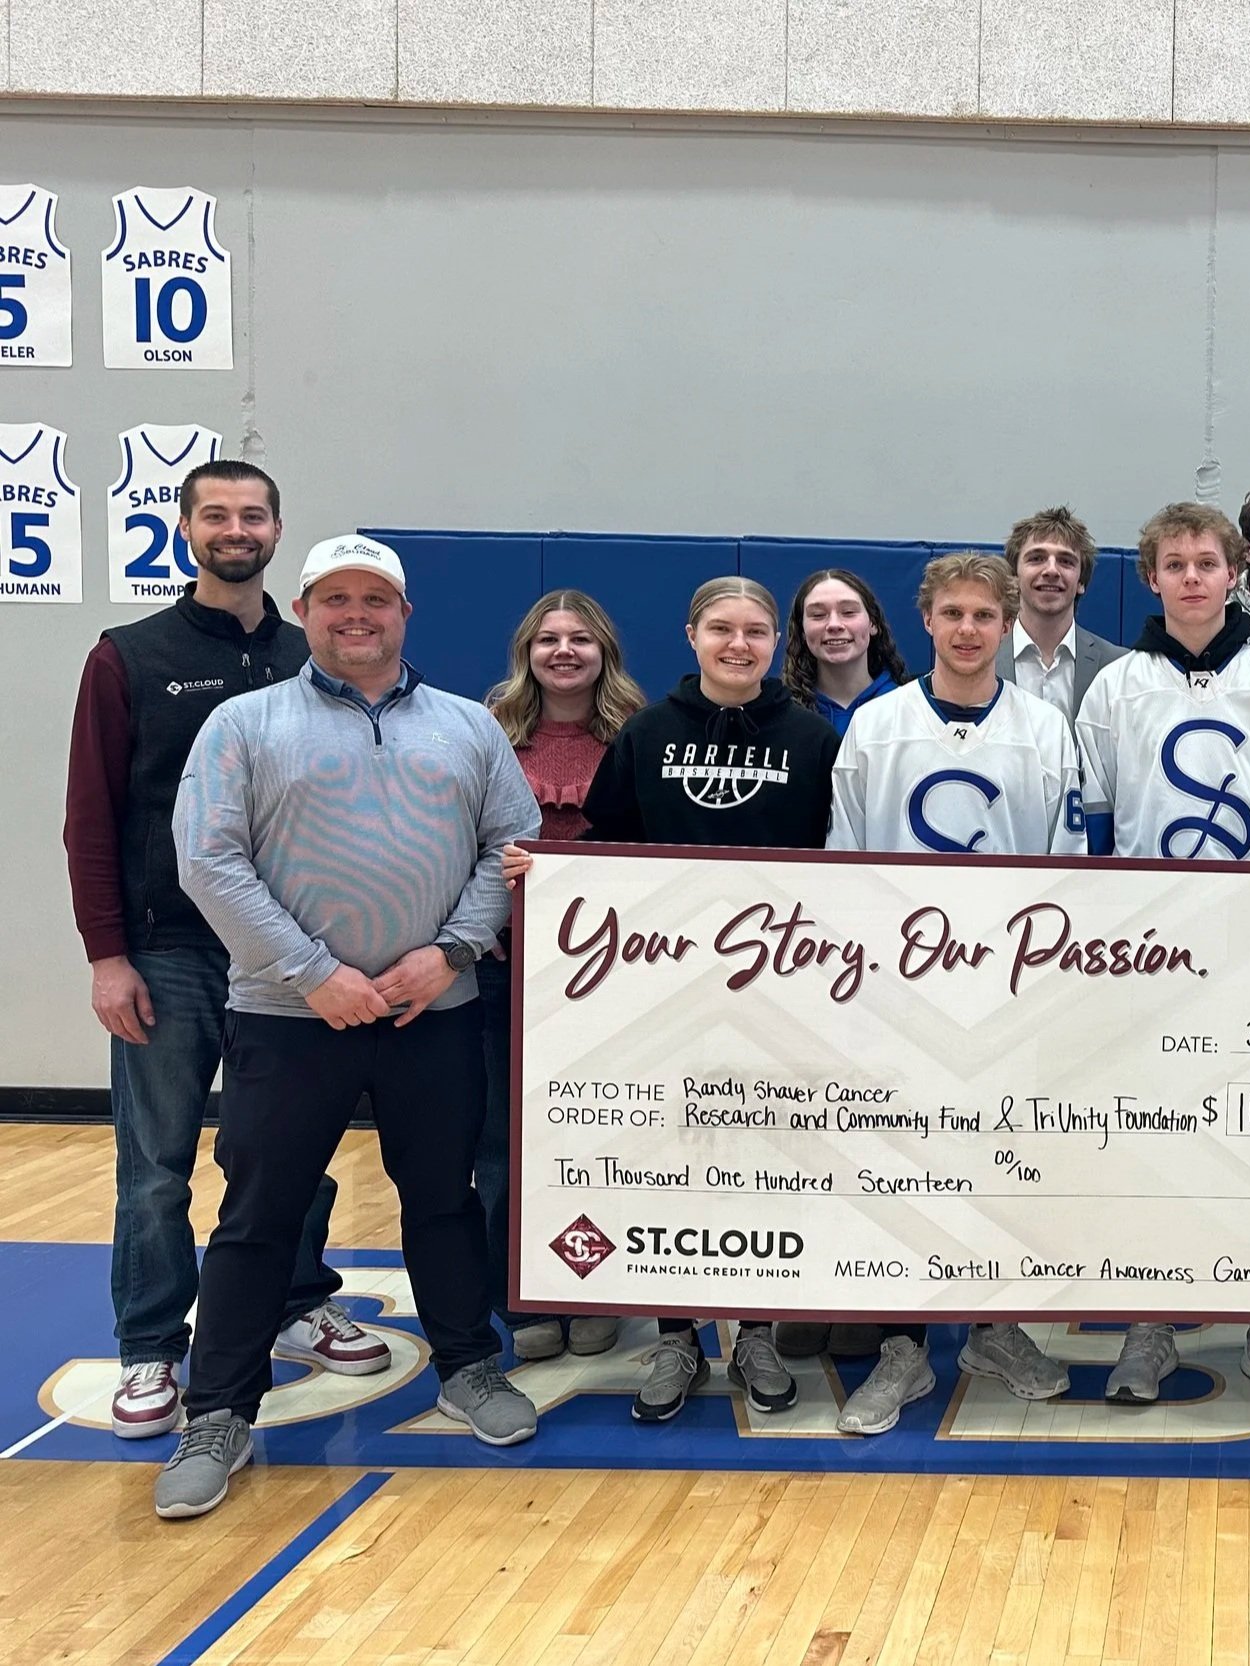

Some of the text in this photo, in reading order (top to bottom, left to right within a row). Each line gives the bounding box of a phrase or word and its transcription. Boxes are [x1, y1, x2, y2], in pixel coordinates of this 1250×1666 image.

[123, 250, 209, 274] SABRES
[135, 276, 208, 343] 10
[143, 349, 193, 363] OLSON
[0, 484, 58, 508] BRES
[183, 678, 224, 690] ST.CLOUD
[663, 743, 790, 771] SARTELL
[668, 767, 781, 781] BASKETBALL
[557, 896, 1208, 1003] Your Story. Our Passion.
[1162, 1035, 1218, 1054] DATE:
[548, 1080, 665, 1102] PAY TO THE
[683, 1076, 899, 1106] Randy Shaver Cancer
[547, 1106, 665, 1128] ORDER OF:
[685, 1101, 776, 1128] Research
[789, 1107, 828, 1131] and
[836, 1106, 929, 1139] Community
[939, 1105, 980, 1133] Fund
[993, 1095, 1023, 1133] &
[1113, 1096, 1198, 1133] Foundation
[1202, 1095, 1218, 1127] $
[554, 1158, 590, 1186] Ten
[596, 1156, 689, 1187] Thousand
[706, 1165, 745, 1188] One
[755, 1170, 833, 1192] Hundred
[857, 1169, 973, 1194] Seventeen
[626, 1226, 804, 1259] ST.CLOUD
[627, 1264, 800, 1279] FINANCIAL CREDIT UNION
[834, 1260, 909, 1278] MEMO:
[928, 1254, 999, 1281] Sartell
[1020, 1256, 1085, 1277] Cancer
[1100, 1258, 1195, 1284] Awareness
